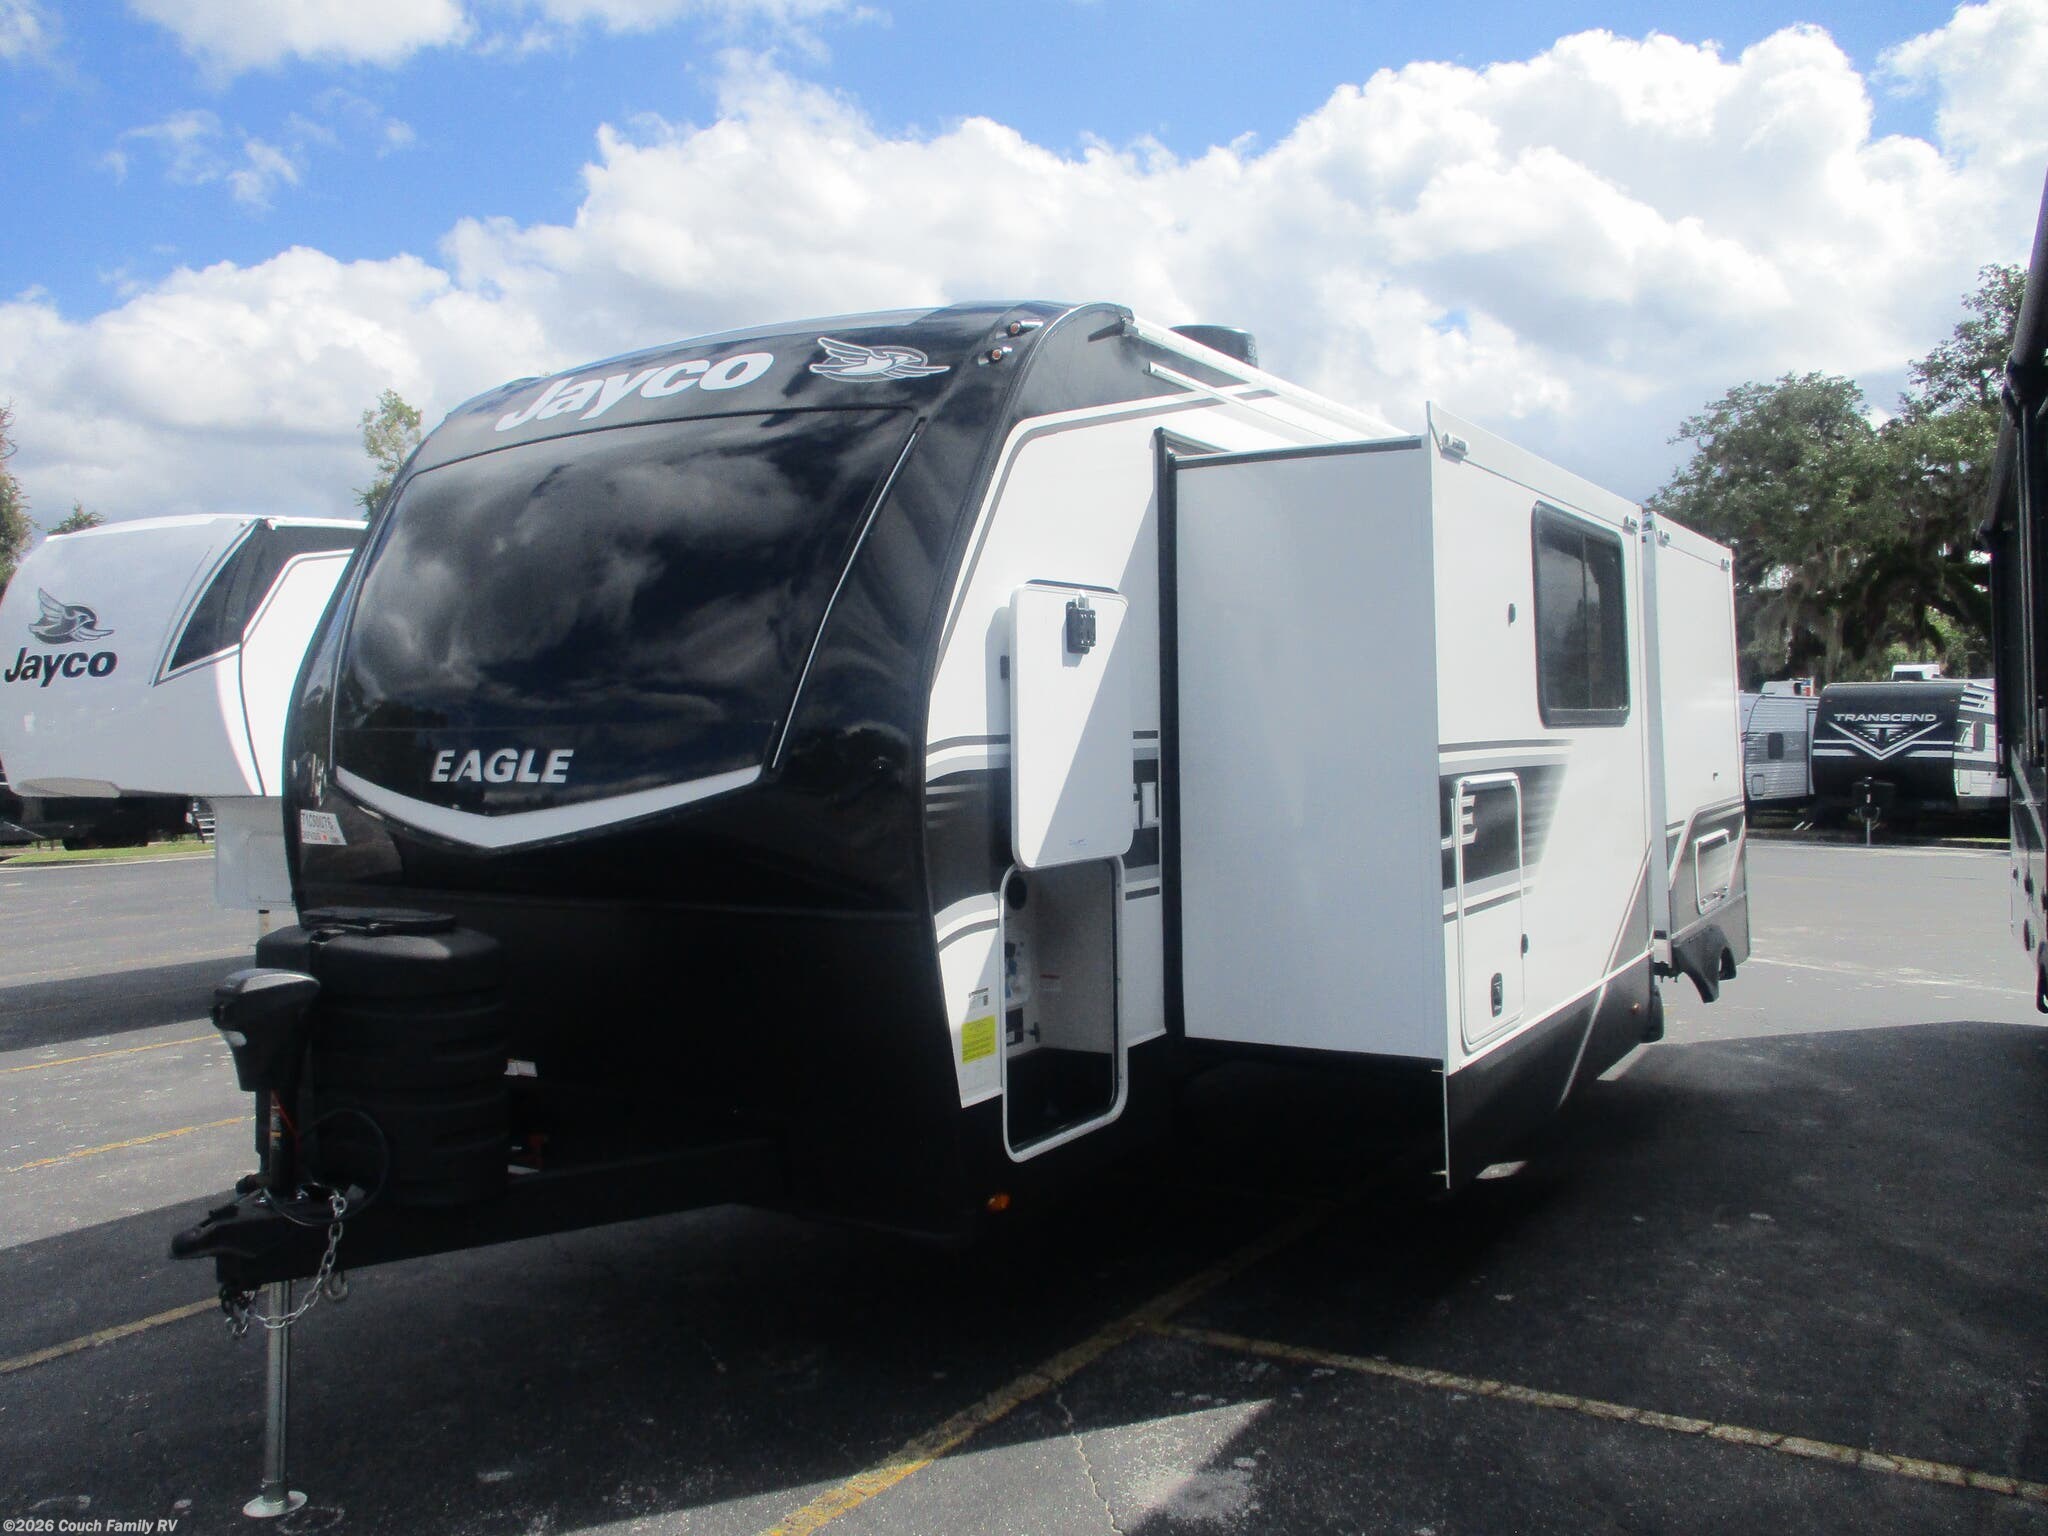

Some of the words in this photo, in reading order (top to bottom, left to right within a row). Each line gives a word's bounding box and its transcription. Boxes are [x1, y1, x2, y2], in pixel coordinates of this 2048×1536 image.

[495, 352, 775, 432] Jayco
[4, 647, 119, 688] Jayco
[1833, 713, 1938, 722] TRANSCEND
[430, 748, 575, 783] EAGLE
